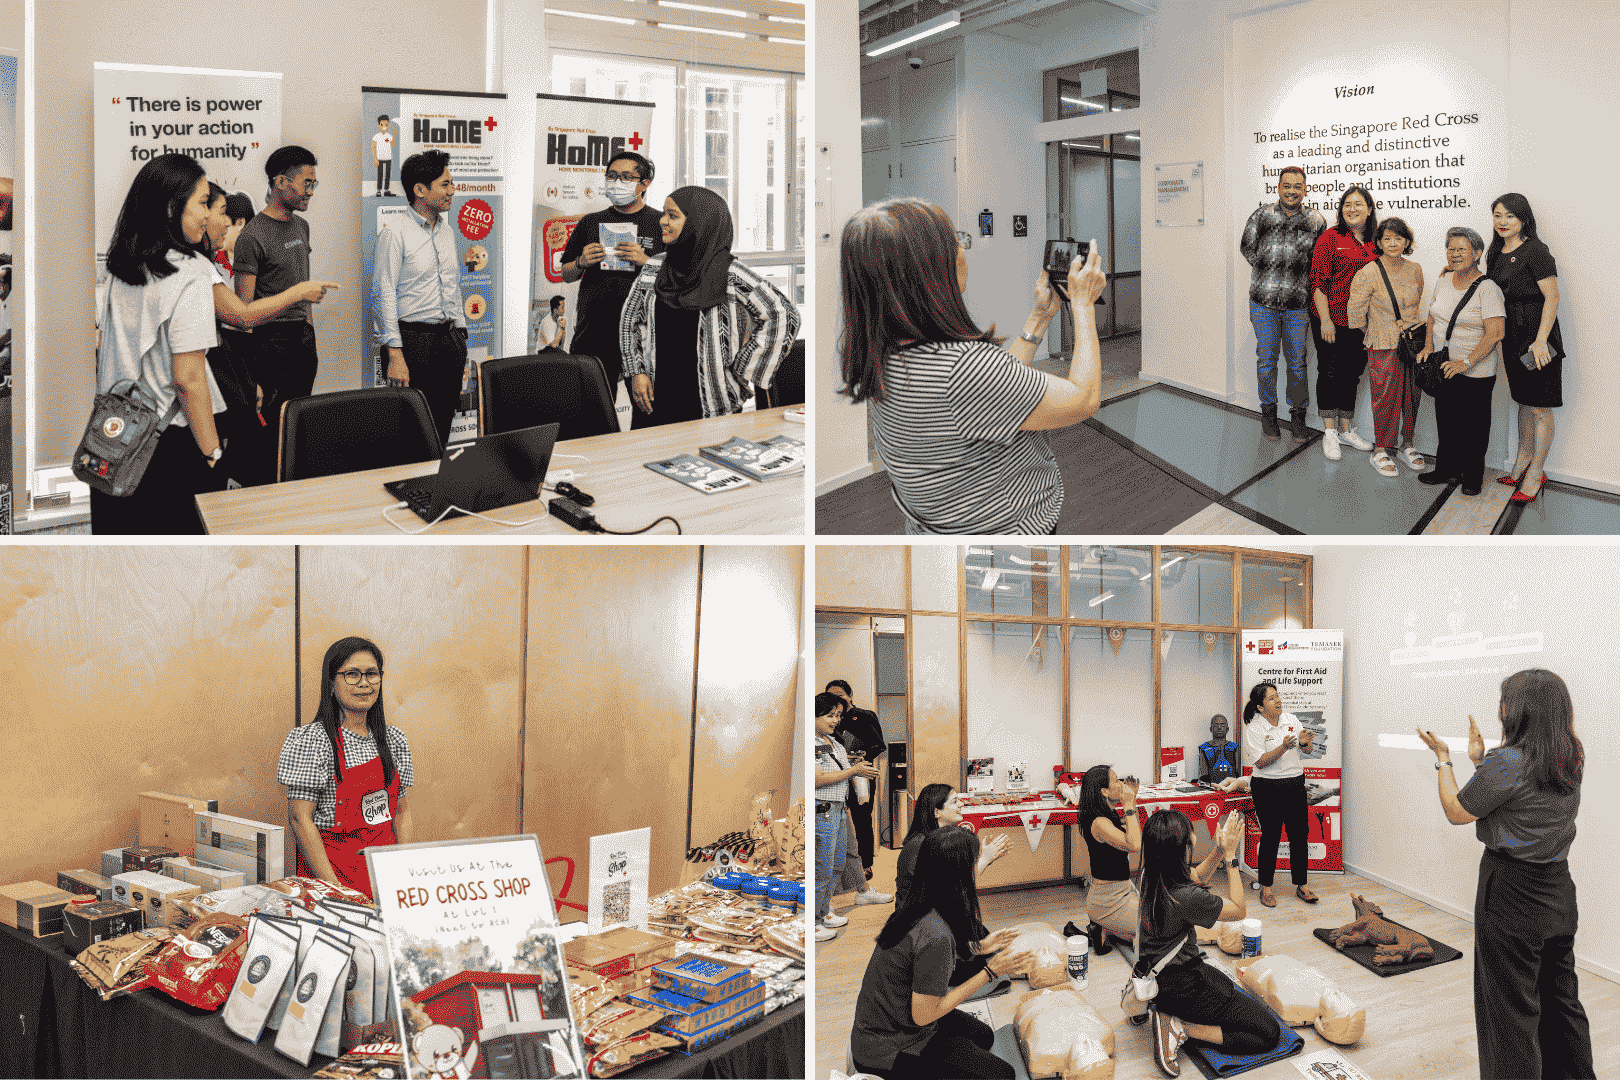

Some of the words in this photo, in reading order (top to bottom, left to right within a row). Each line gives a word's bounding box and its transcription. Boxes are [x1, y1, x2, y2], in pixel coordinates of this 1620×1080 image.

[1334, 84, 1375, 99] Vision
[126, 96, 181, 112] There
[186, 96, 201, 112] is
[206, 99, 262, 115] power
[129, 121, 147, 136] in
[151, 123, 193, 139] your
[198, 120, 254, 135] action
[1253, 131, 1267, 143] To
[1270, 127, 1306, 142] realise
[1309, 125, 1328, 139] the
[1330, 121, 1398, 138] Singapore
[1402, 114, 1430, 130] Red
[1434, 111, 1479, 126] Cross
[130, 144, 158, 161] for
[1272, 149, 1285, 159] as
[1287, 149, 1294, 158] a
[1297, 143, 1342, 159] leading
[1345, 139, 1370, 154] and
[1374, 134, 1450, 152] distinctive
[1344, 157, 1430, 176] organisation
[1435, 153, 1466, 168] that
[1377, 175, 1461, 191] institutions
[1387, 195, 1471, 210] vulnerable.
[463, 205, 492, 223] ZERO
[466, 223, 479, 235] FEE
[1258, 667, 1282, 675] Centre
[1284, 667, 1295, 675] for
[1296, 667, 1312, 675] First
[1314, 667, 1327, 675] Aid
[1262, 677, 1277, 685] and
[1278, 677, 1292, 685] Life
[1293, 677, 1323, 687] Support
[365, 803, 387, 822] Shop
[449, 863, 465, 873] Us
[470, 861, 485, 871] At
[489, 859, 512, 870] The
[608, 859, 628, 878] Shop
[396, 886, 430, 909] RED
[436, 880, 488, 904] CROSS
[493, 876, 531, 898] SHOP
